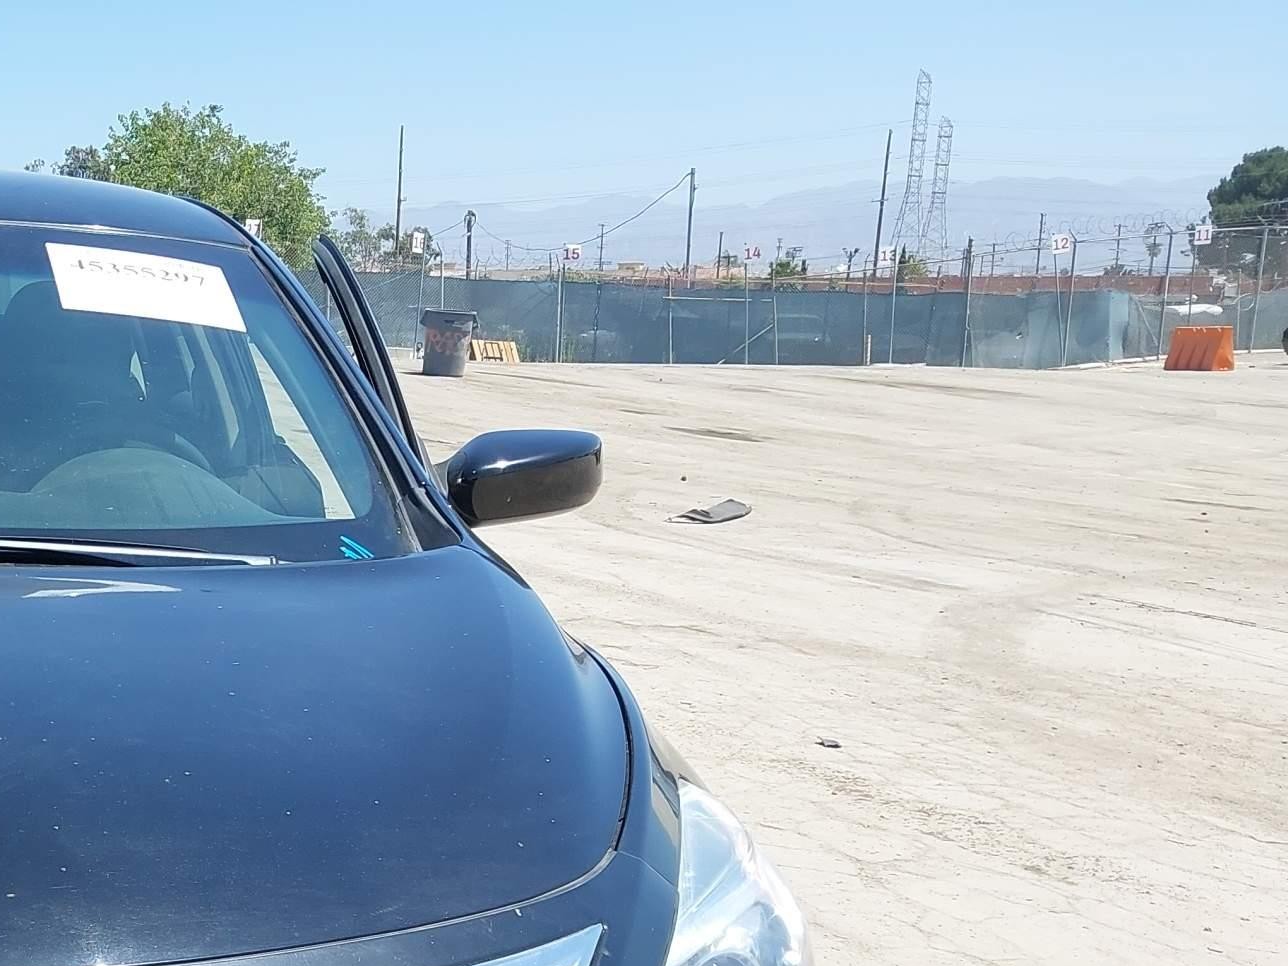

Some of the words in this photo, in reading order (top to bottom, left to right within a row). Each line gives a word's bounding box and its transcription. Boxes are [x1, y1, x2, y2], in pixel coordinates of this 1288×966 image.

[1196, 229, 1210, 241] 11
[1053, 237, 1069, 250] 12
[563, 247, 580, 260] 15
[744, 246, 761, 260] 14
